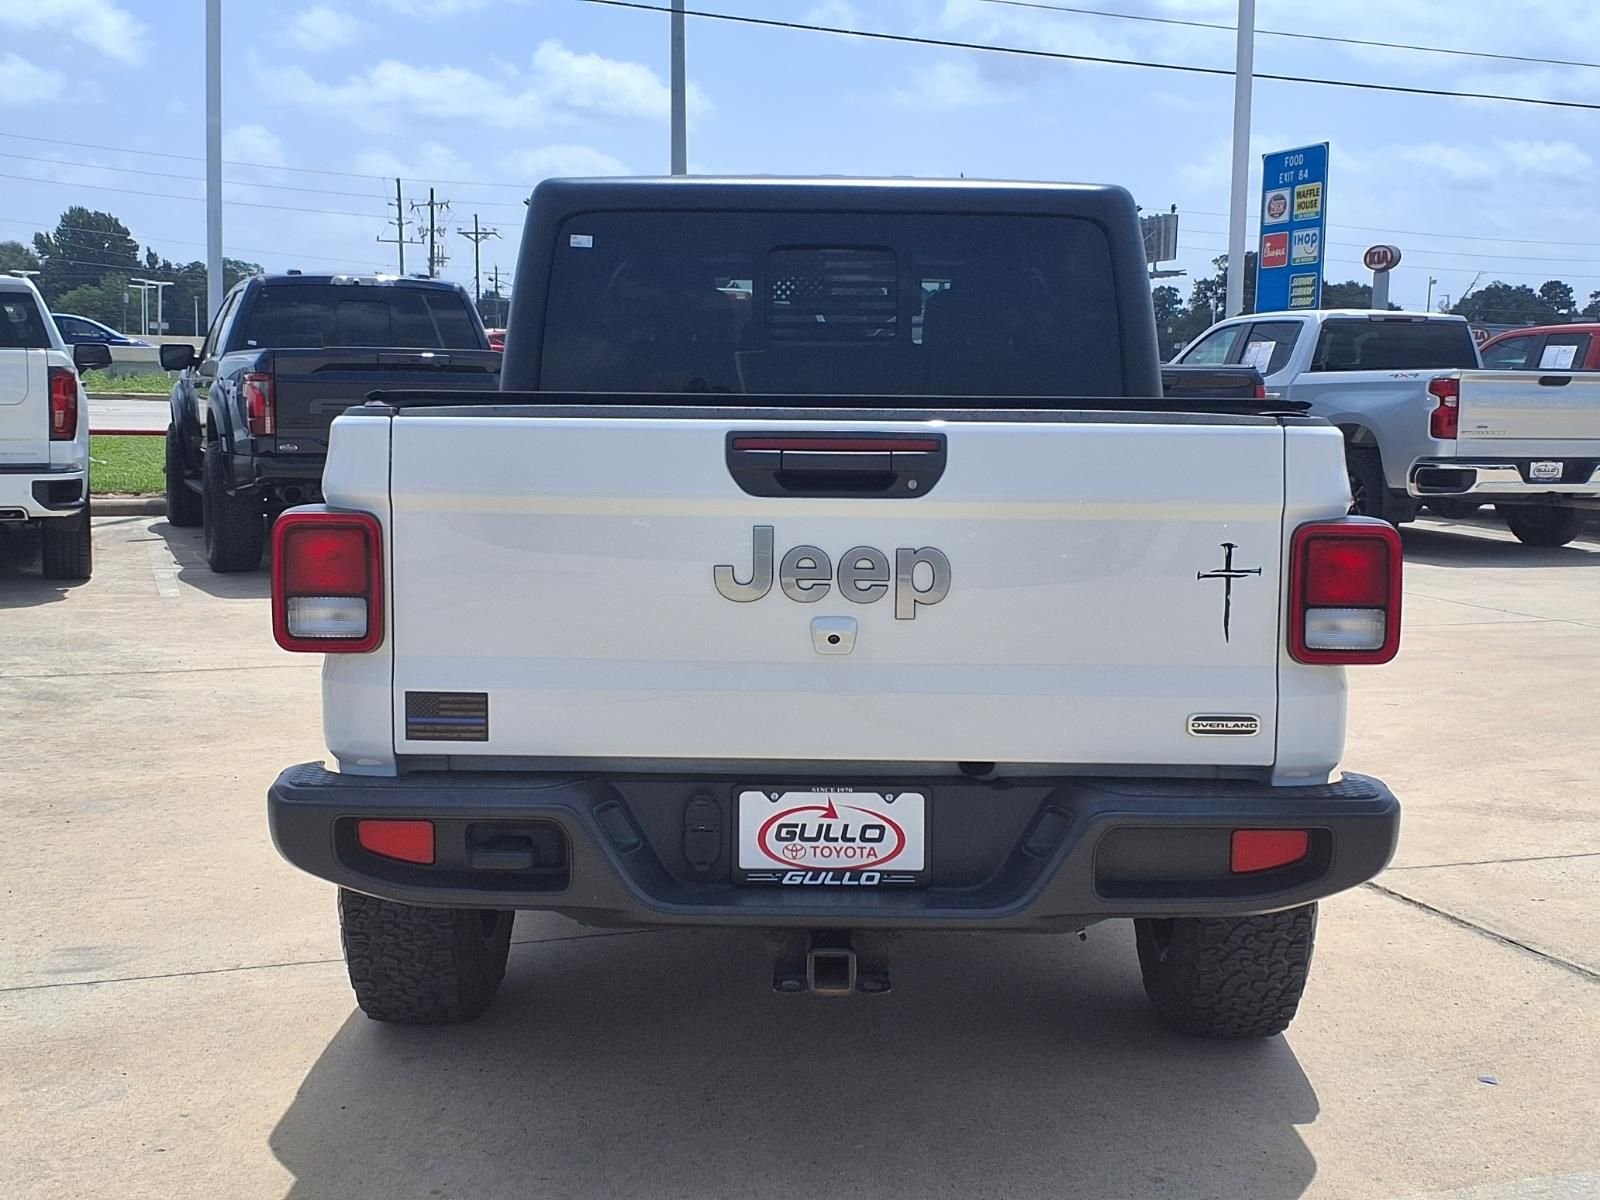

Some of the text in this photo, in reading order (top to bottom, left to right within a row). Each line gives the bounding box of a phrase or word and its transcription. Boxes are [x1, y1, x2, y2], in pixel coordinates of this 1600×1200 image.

[1284, 154, 1303, 167] FOOD
[1279, 168, 1309, 183] EXIT 84
[1296, 187, 1320, 200] WAFFLE
[1296, 199, 1318, 211] HOUSE
[1369, 250, 1389, 265] KIA
[713, 525, 952, 620] Jeep
[774, 823, 886, 843] GULLO
[810, 846, 878, 859] TOYOTA
[782, 871, 881, 885] GULLO
